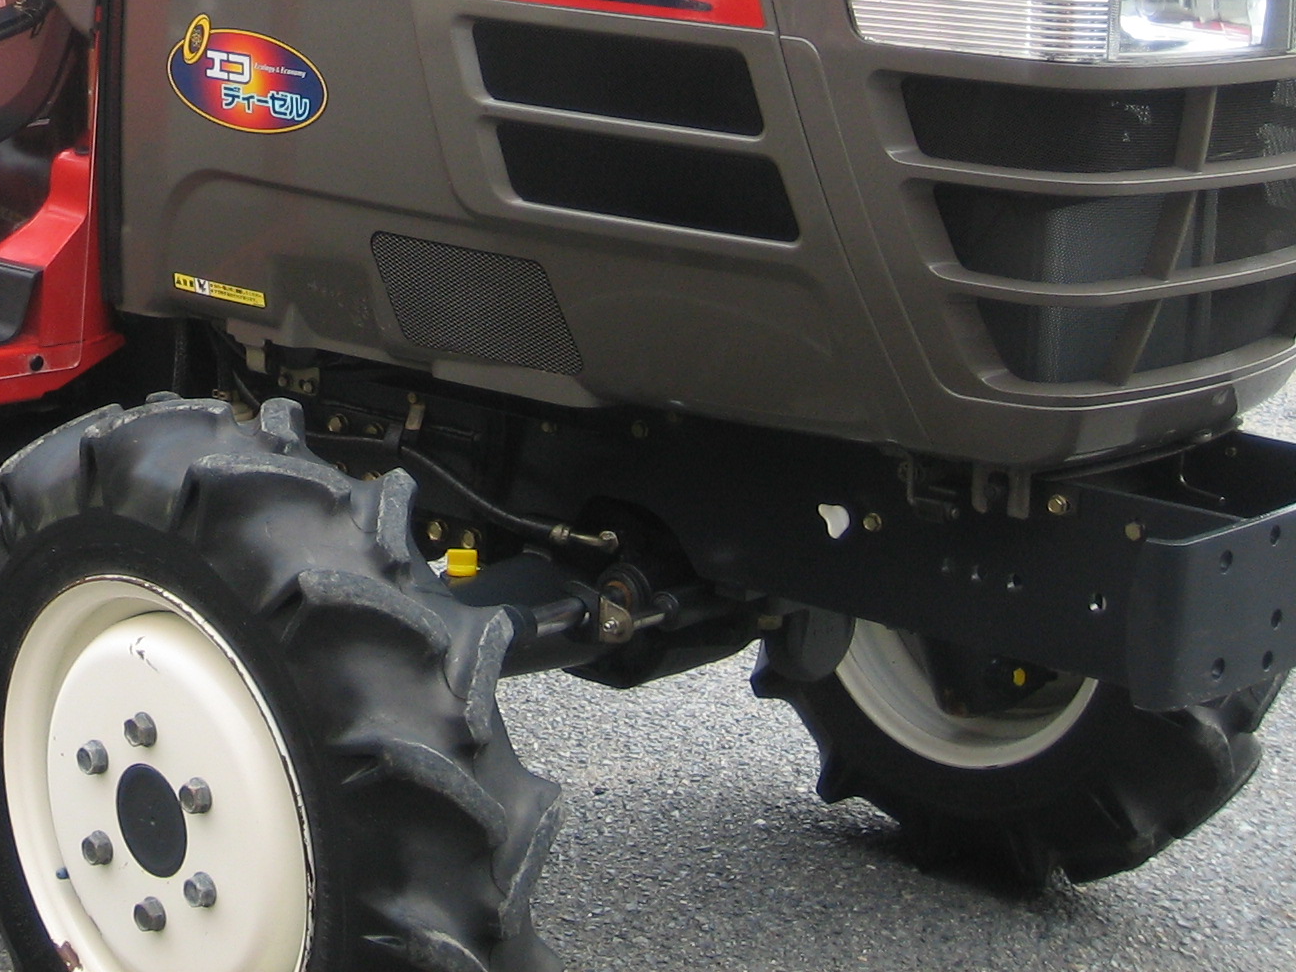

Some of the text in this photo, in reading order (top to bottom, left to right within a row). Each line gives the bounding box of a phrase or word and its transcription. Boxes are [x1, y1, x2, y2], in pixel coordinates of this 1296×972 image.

[205, 49, 252, 85] エコ
[221, 83, 311, 121] ディーゼル
